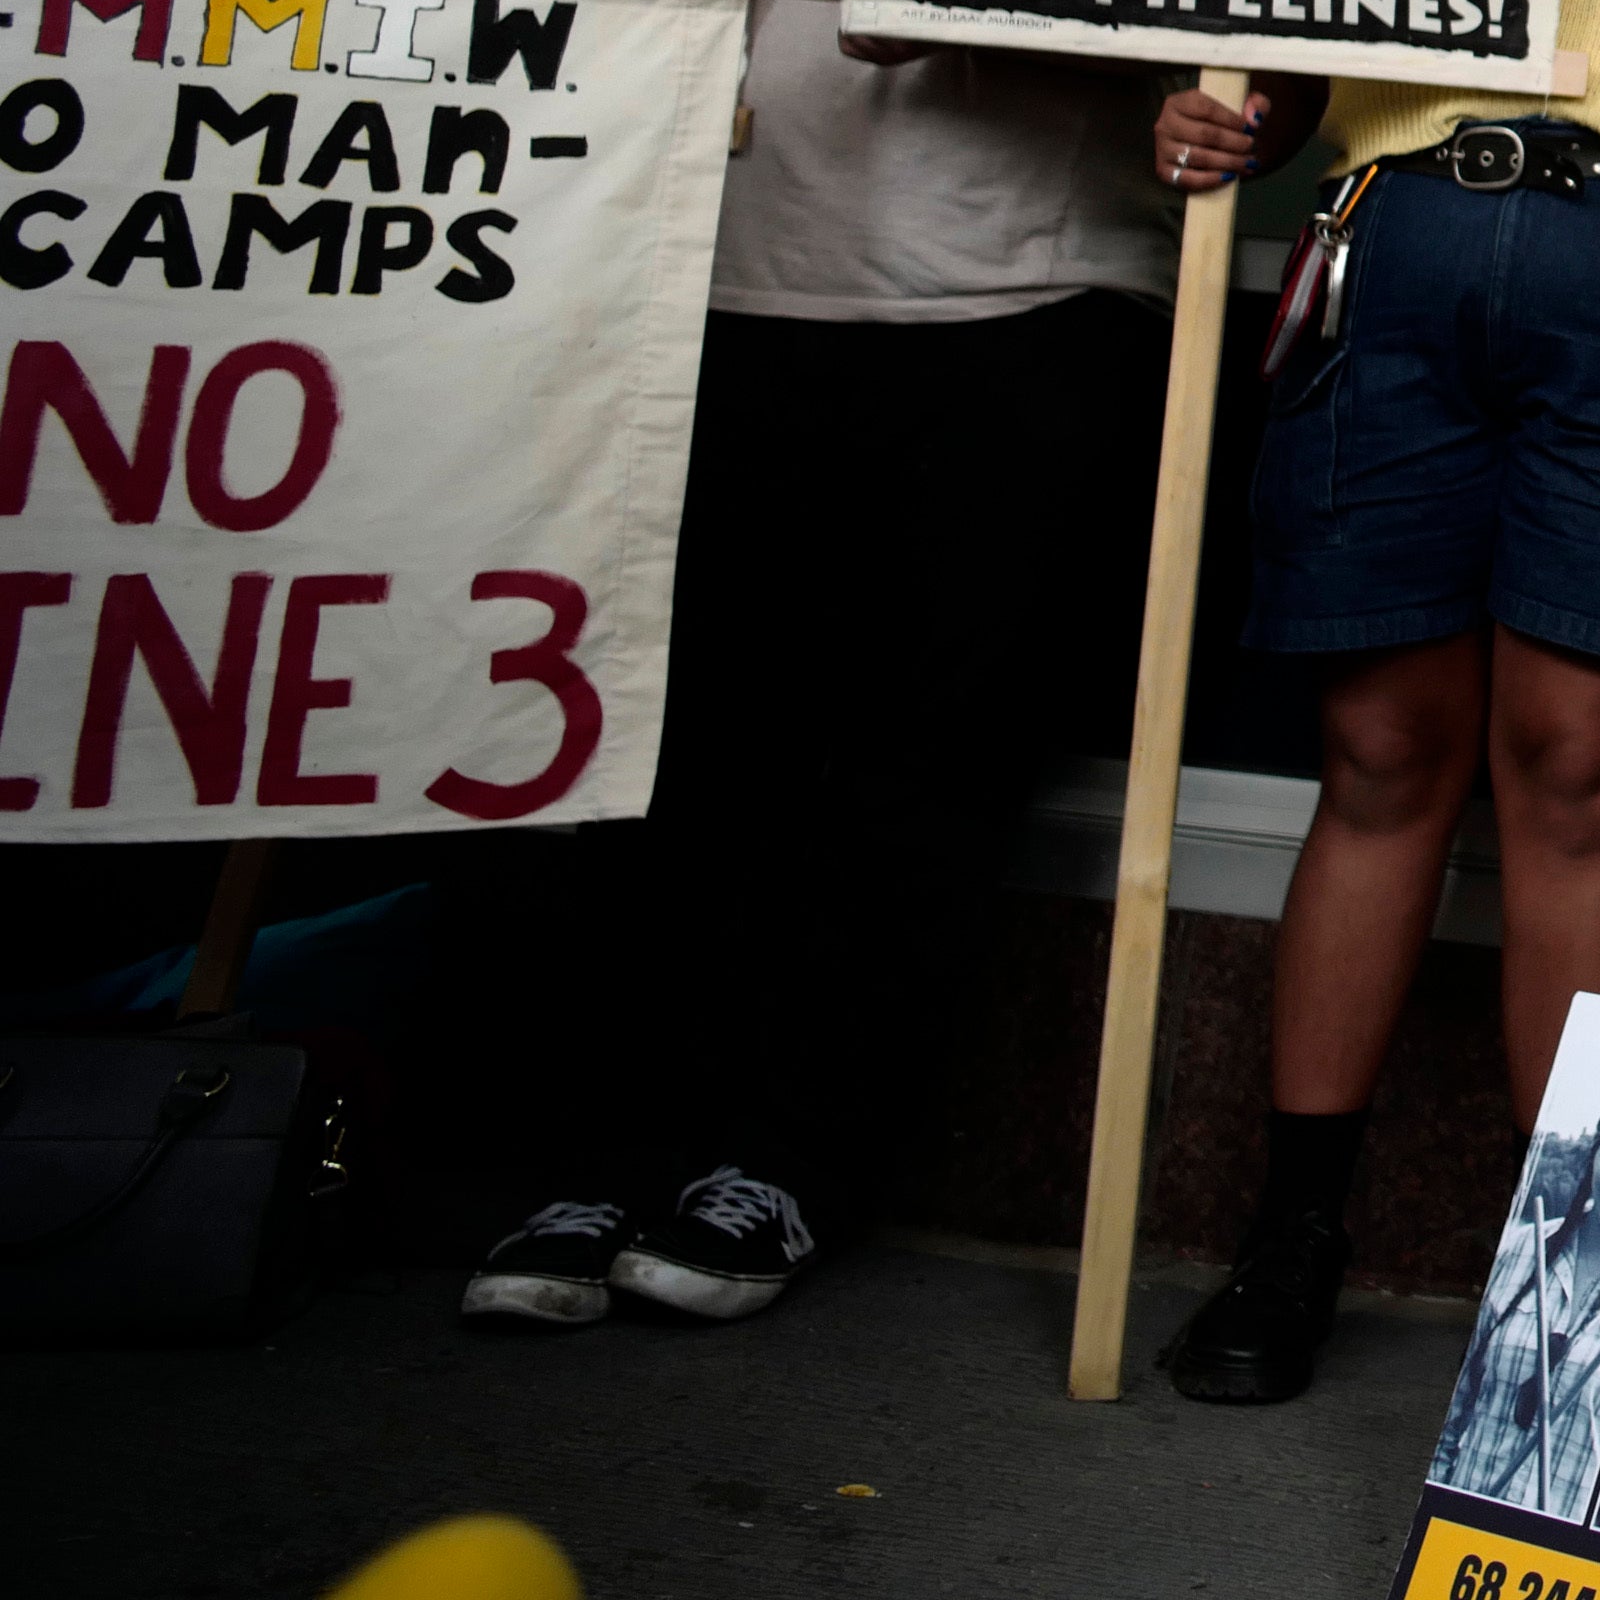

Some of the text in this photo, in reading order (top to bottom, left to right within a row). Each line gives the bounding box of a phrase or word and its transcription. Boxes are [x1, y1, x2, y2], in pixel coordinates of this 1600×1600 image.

[0, 189, 520, 304] CAMPS
[0, 339, 341, 533] NO
[423, 569, 604, 821] 3
